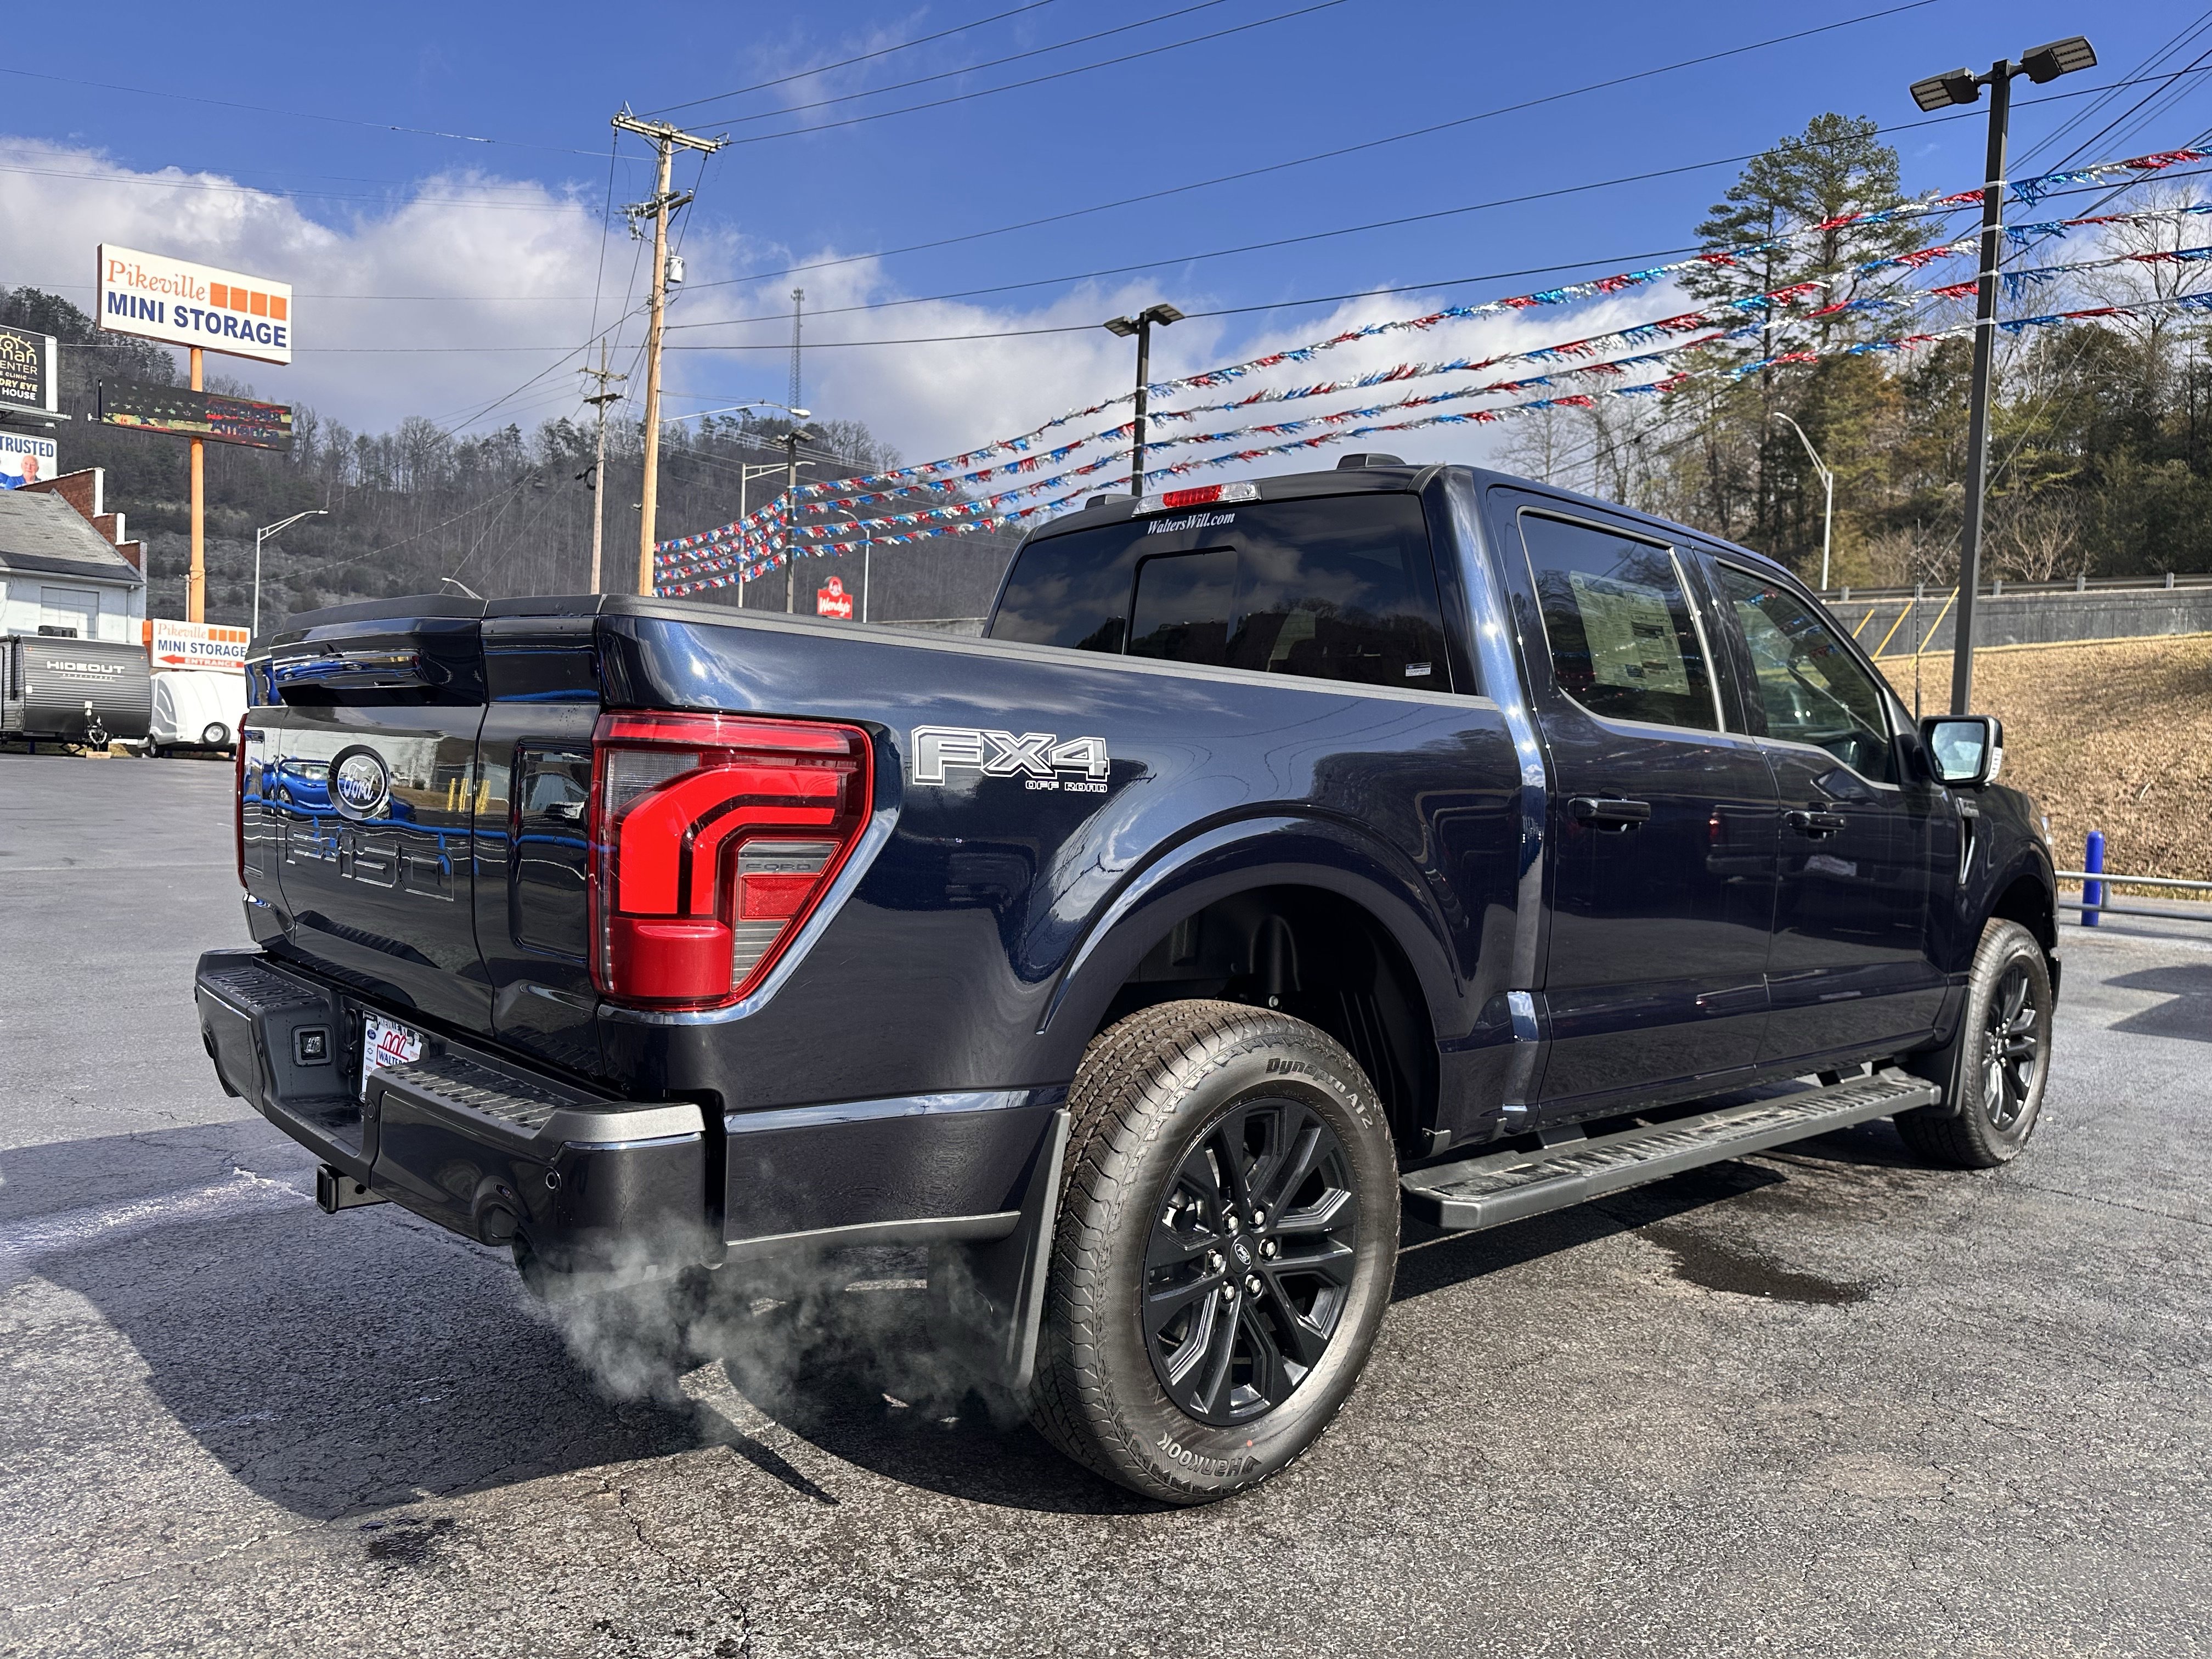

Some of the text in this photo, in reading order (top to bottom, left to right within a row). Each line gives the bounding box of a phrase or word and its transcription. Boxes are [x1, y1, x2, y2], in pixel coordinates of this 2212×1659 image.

[106, 259, 206, 301] Pikeville
[108, 291, 287, 348] MINI STORAGE
[0, 377, 38, 392] DRY EYE
[5, 371, 27, 380] CLINIC
[2, 387, 36, 400] HOUSE
[0, 436, 54, 458] TRUSTED
[1147, 512, 1235, 535] WaltersWill.com
[819, 596, 850, 617] Wendy's
[157, 623, 206, 639] Pikeville
[158, 639, 247, 657] MINI STORAGE
[47, 661, 125, 674] HIDEOUT
[184, 658, 237, 668] ENTRANCE
[911, 725, 1110, 786] FX4
[1025, 780, 1108, 793] OFF ROAD
[1265, 1058, 1373, 1129] Dynapro AT2
